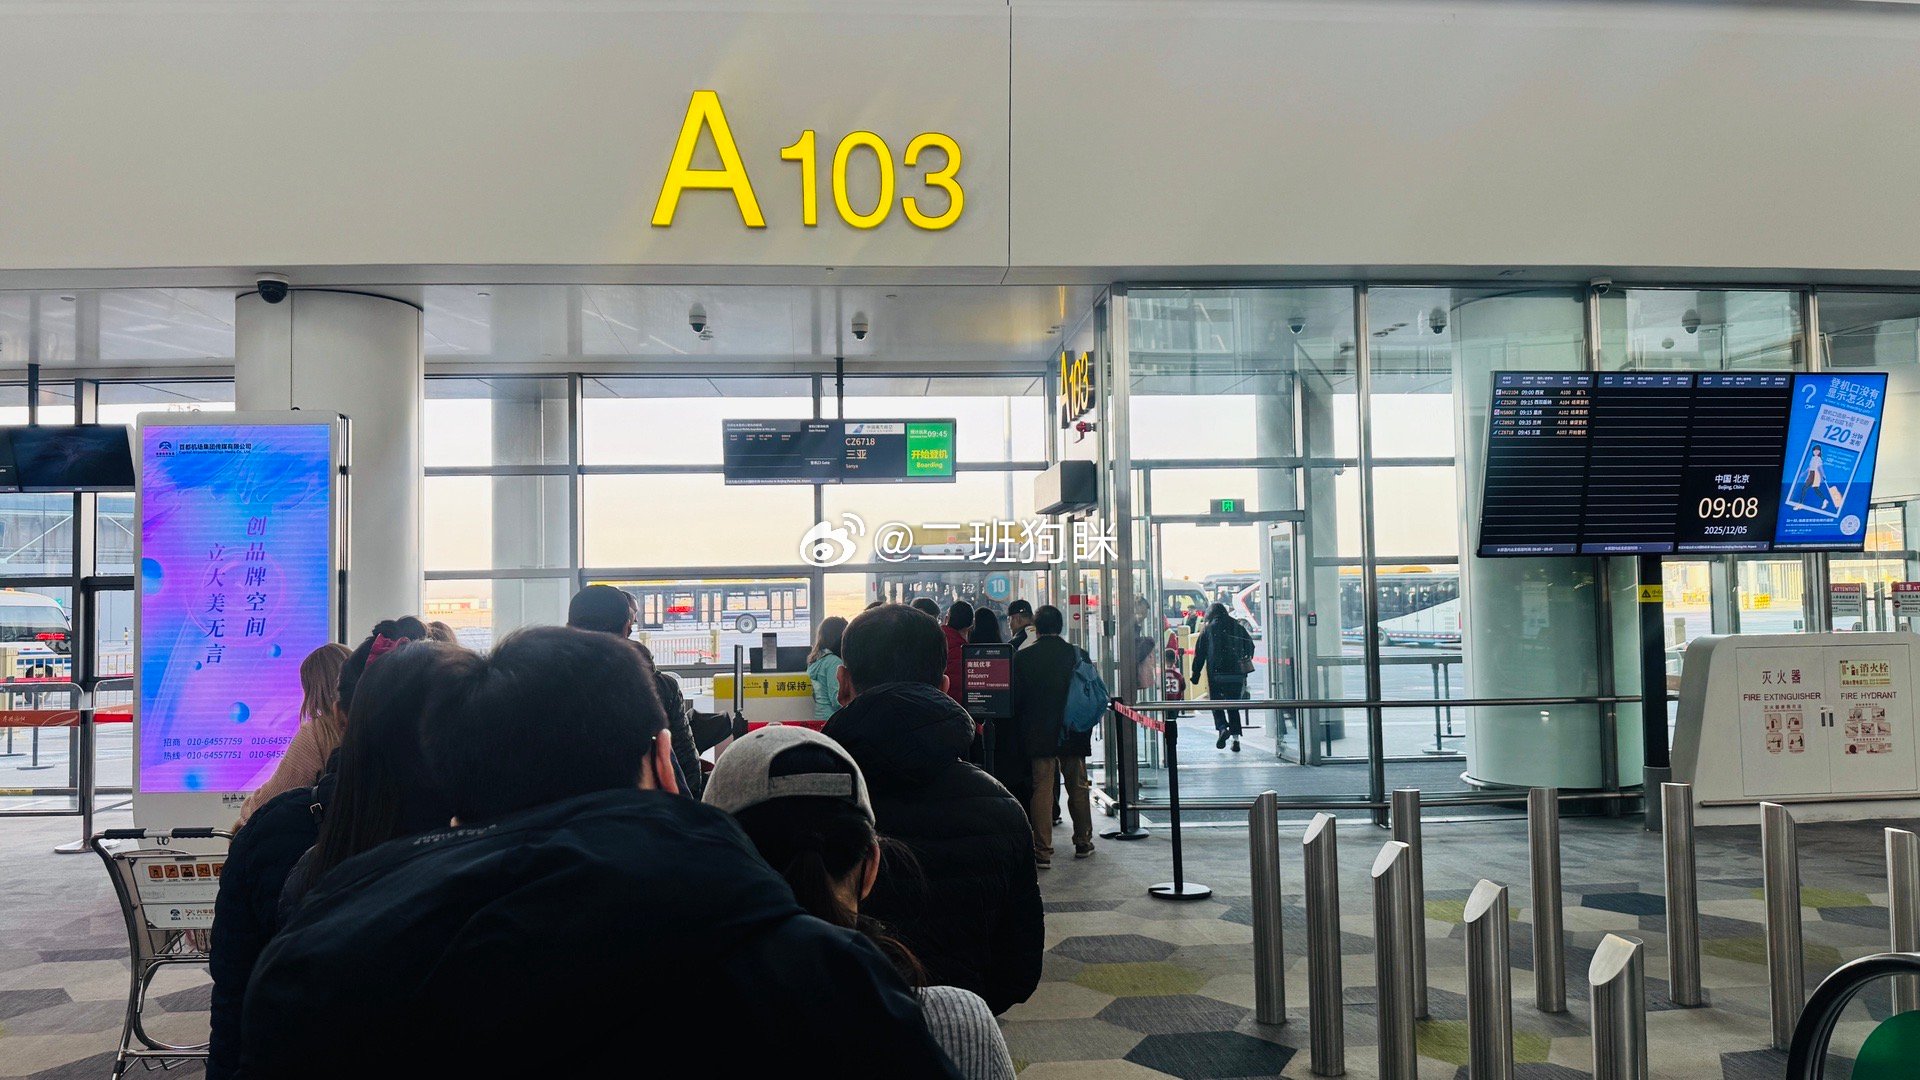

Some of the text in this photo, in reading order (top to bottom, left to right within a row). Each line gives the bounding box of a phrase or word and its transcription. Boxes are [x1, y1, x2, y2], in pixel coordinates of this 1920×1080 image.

[651, 90, 966, 231] A103
[1059, 351, 1089, 423] A103
[1830, 377, 1880, 400] 登机口没有
[1826, 388, 1875, 410] 显示怎么办
[927, 430, 948, 438] 09:45
[1823, 424, 1852, 444] 120
[845, 437, 876, 446] CZ6718
[846, 449, 867, 460] 三亚
[911, 448, 949, 460] 开始登机
[917, 461, 944, 470] Boarding
[1715, 474, 1750, 484] 中国 北京
[1698, 497, 1759, 519] 09:08
[1703, 525, 1748, 535] 2025/12/05
[245, 515, 267, 638] 创品牌空间
[991, 579, 1006, 593] 10
[1899, 583, 1912, 591] 注意
[204, 542, 226, 665] 立大美无言
[1860, 663, 1889, 673] 消火栓
[1762, 669, 1801, 684] 灭火器
[1743, 692, 1822, 701] FIRE EXTINGUISHER
[1840, 691, 1897, 700] FIRE HYDRANT
[163, 738, 181, 747] 招商
[187, 738, 243, 746] 010-64557759
[163, 751, 181, 761] 热线
[187, 751, 242, 760] 010-64557751
